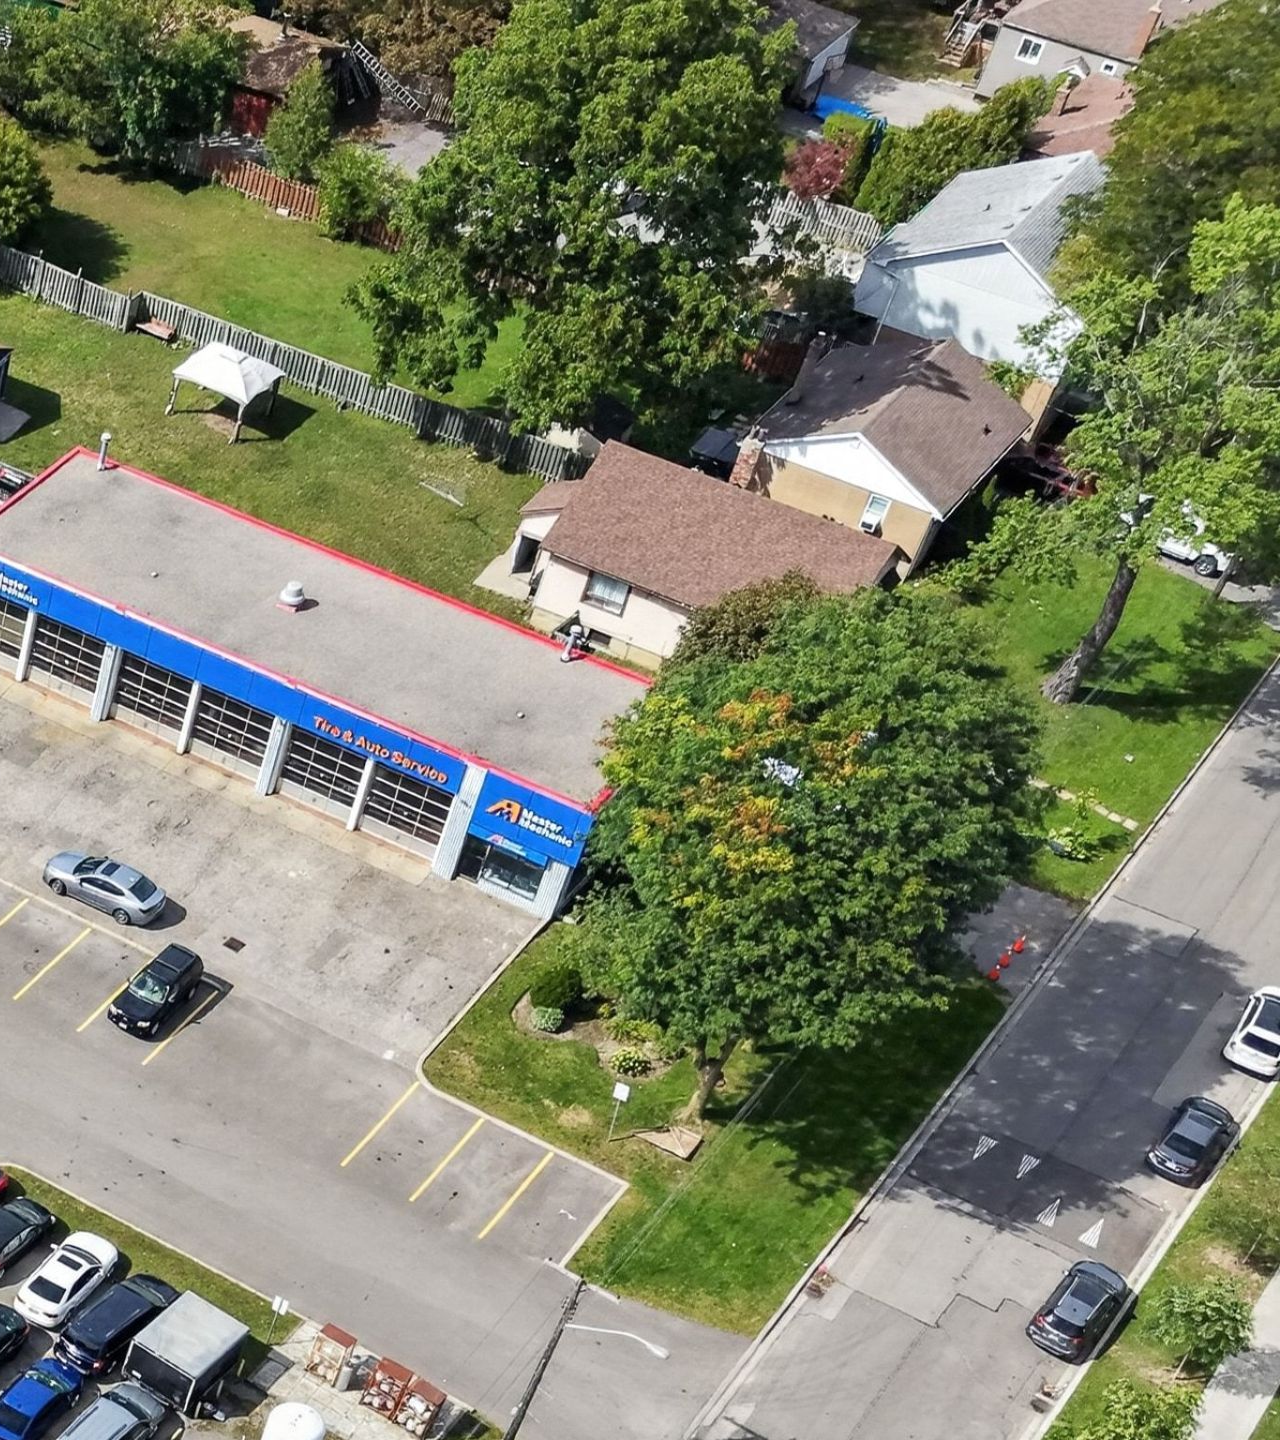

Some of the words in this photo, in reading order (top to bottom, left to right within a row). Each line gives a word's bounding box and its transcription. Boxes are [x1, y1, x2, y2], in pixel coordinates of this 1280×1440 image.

[314, 716, 341, 737] Tire
[342, 730, 353, 743] &
[355, 735, 390, 758] Auto
[392, 751, 448, 784] Service
[518, 819, 573, 848] Mechanic
[523, 808, 563, 833] Master
